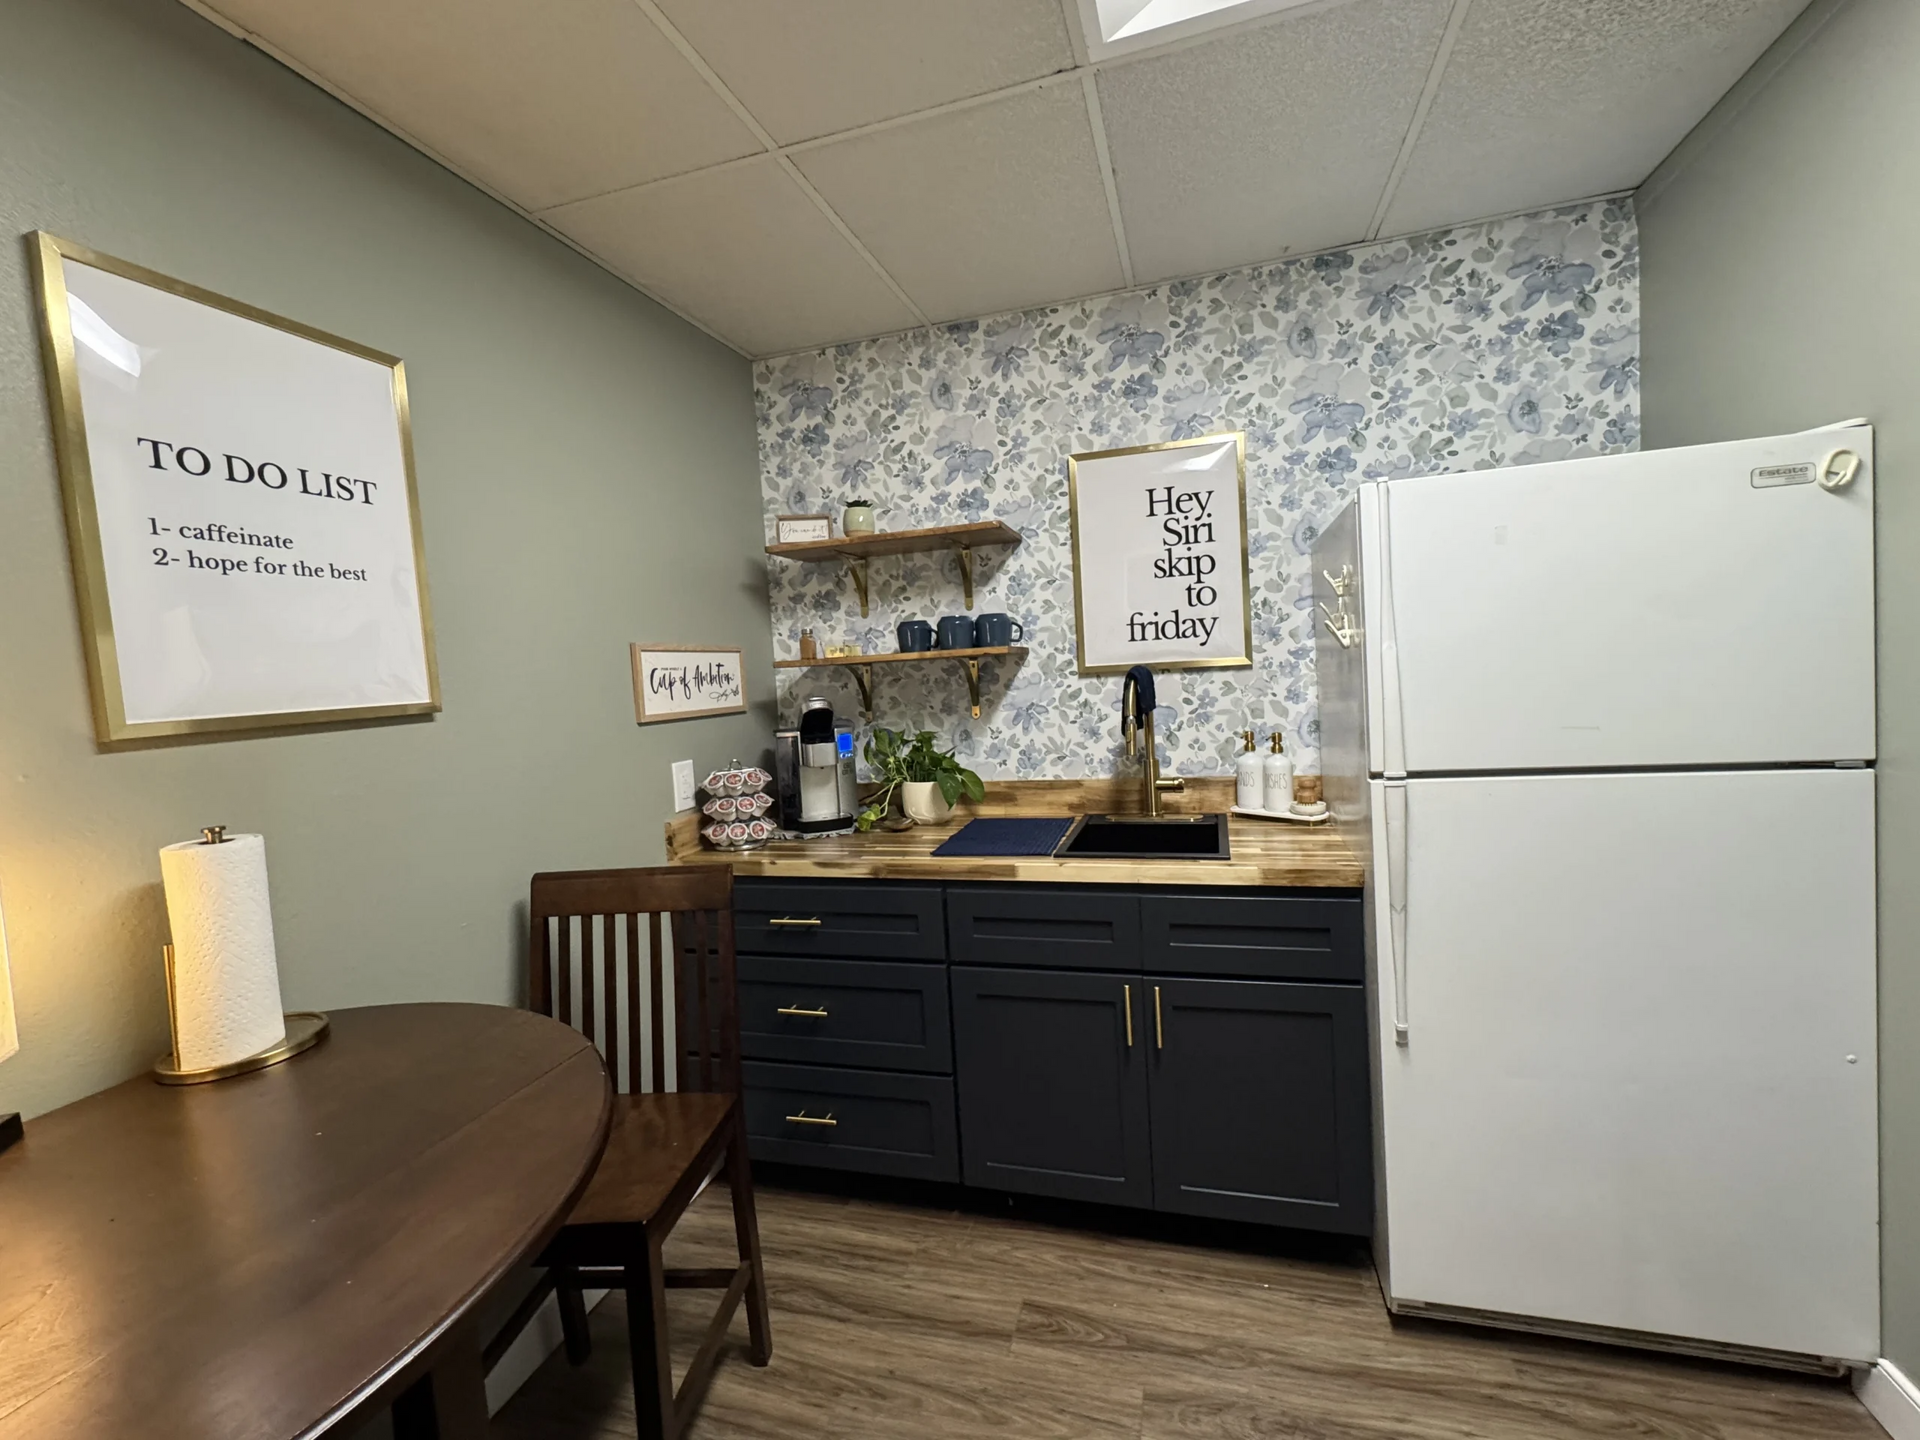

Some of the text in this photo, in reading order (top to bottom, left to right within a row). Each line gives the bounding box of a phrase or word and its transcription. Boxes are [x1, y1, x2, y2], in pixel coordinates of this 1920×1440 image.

[137, 437, 377, 505] TO DO LIST
[1758, 466, 1809, 477] Estate
[1145, 486, 1214, 522] Hey
[147, 517, 294, 549] 1- caffeinate
[1162, 512, 1216, 547] Siri
[152, 547, 368, 581] 2- hope for the best
[1153, 546, 1216, 584] skip
[1185, 583, 1217, 607] to
[1126, 609, 1219, 646] friday
[650, 667, 677, 701] Cup
[679, 666, 691, 700] of
